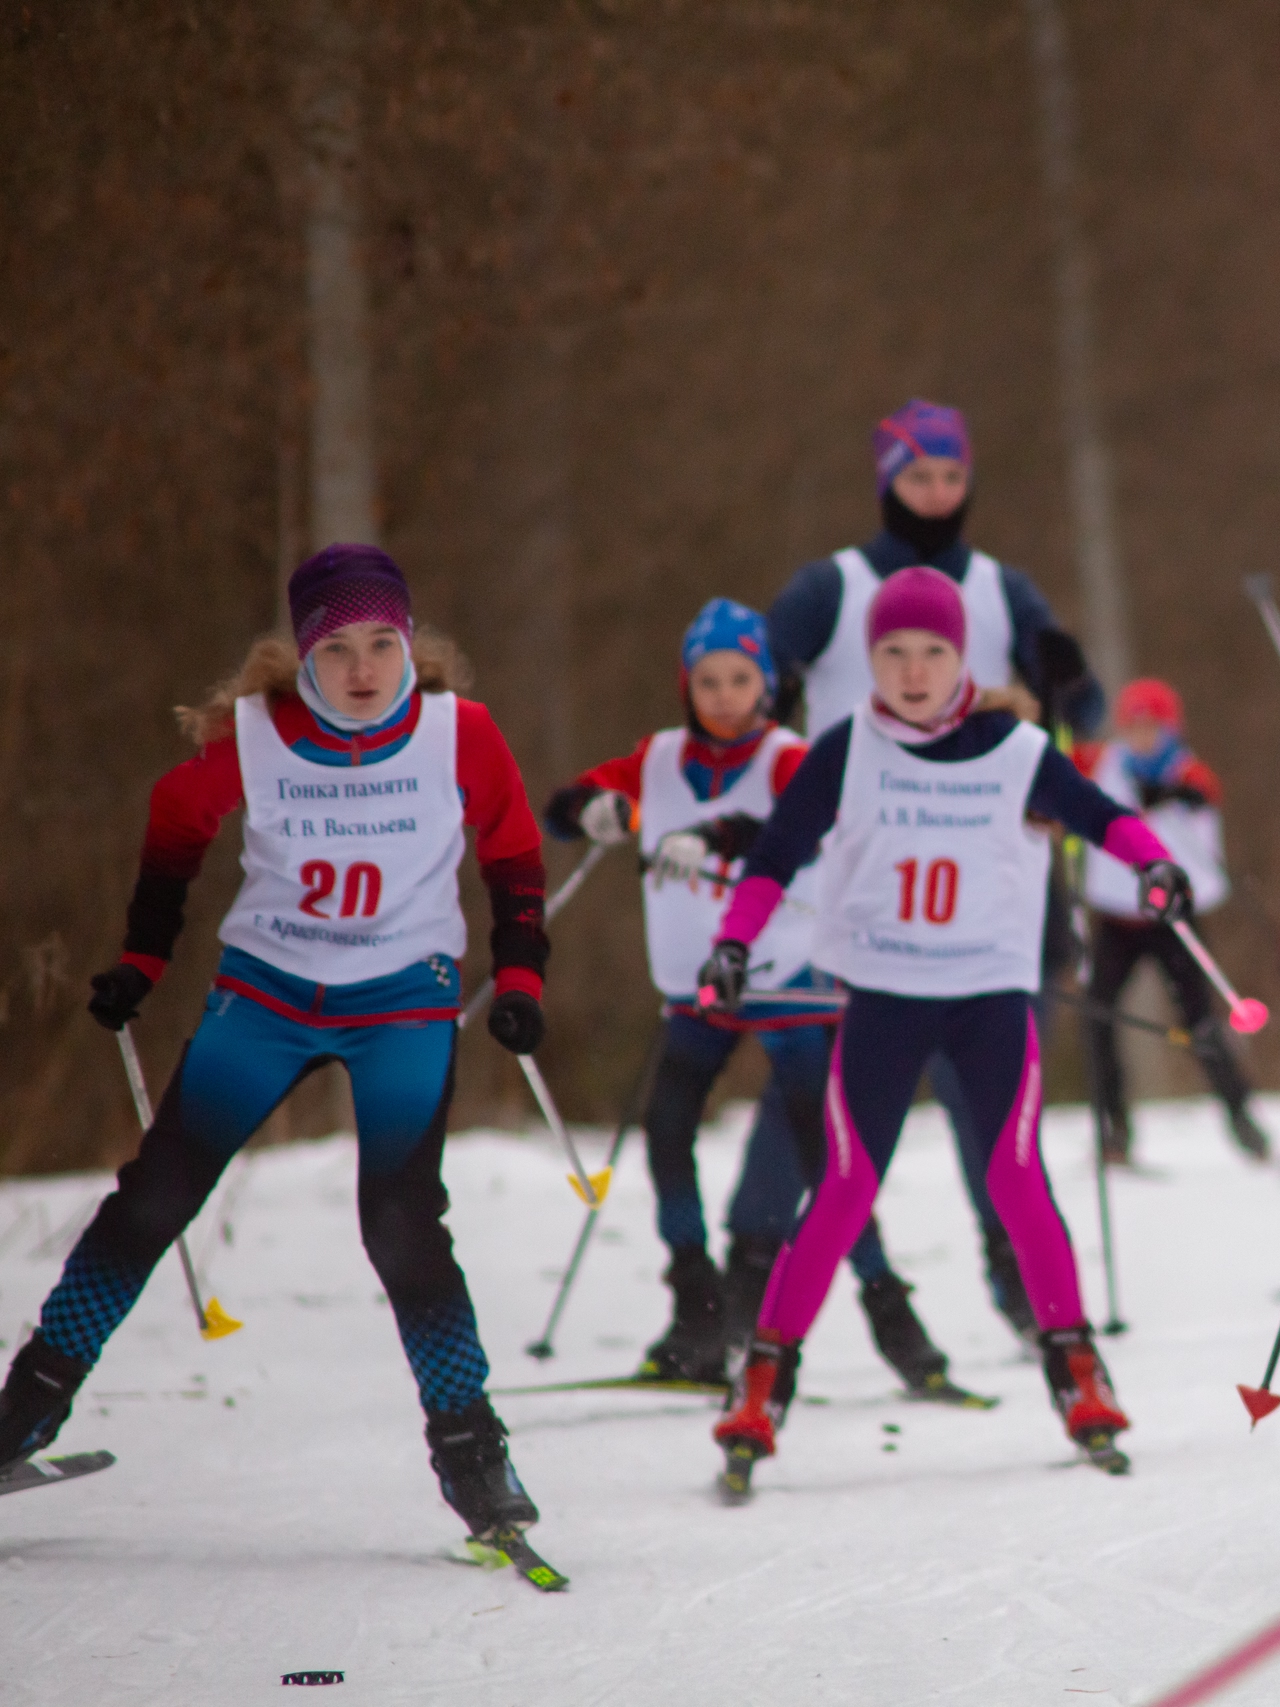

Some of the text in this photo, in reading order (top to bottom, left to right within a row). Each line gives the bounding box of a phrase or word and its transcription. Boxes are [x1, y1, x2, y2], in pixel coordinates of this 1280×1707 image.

[278, 777, 418, 799] Гонка памяти
[324, 817, 417, 837] Васильева
[298, 858, 382, 919] 20
[895, 857, 959, 926] 10
